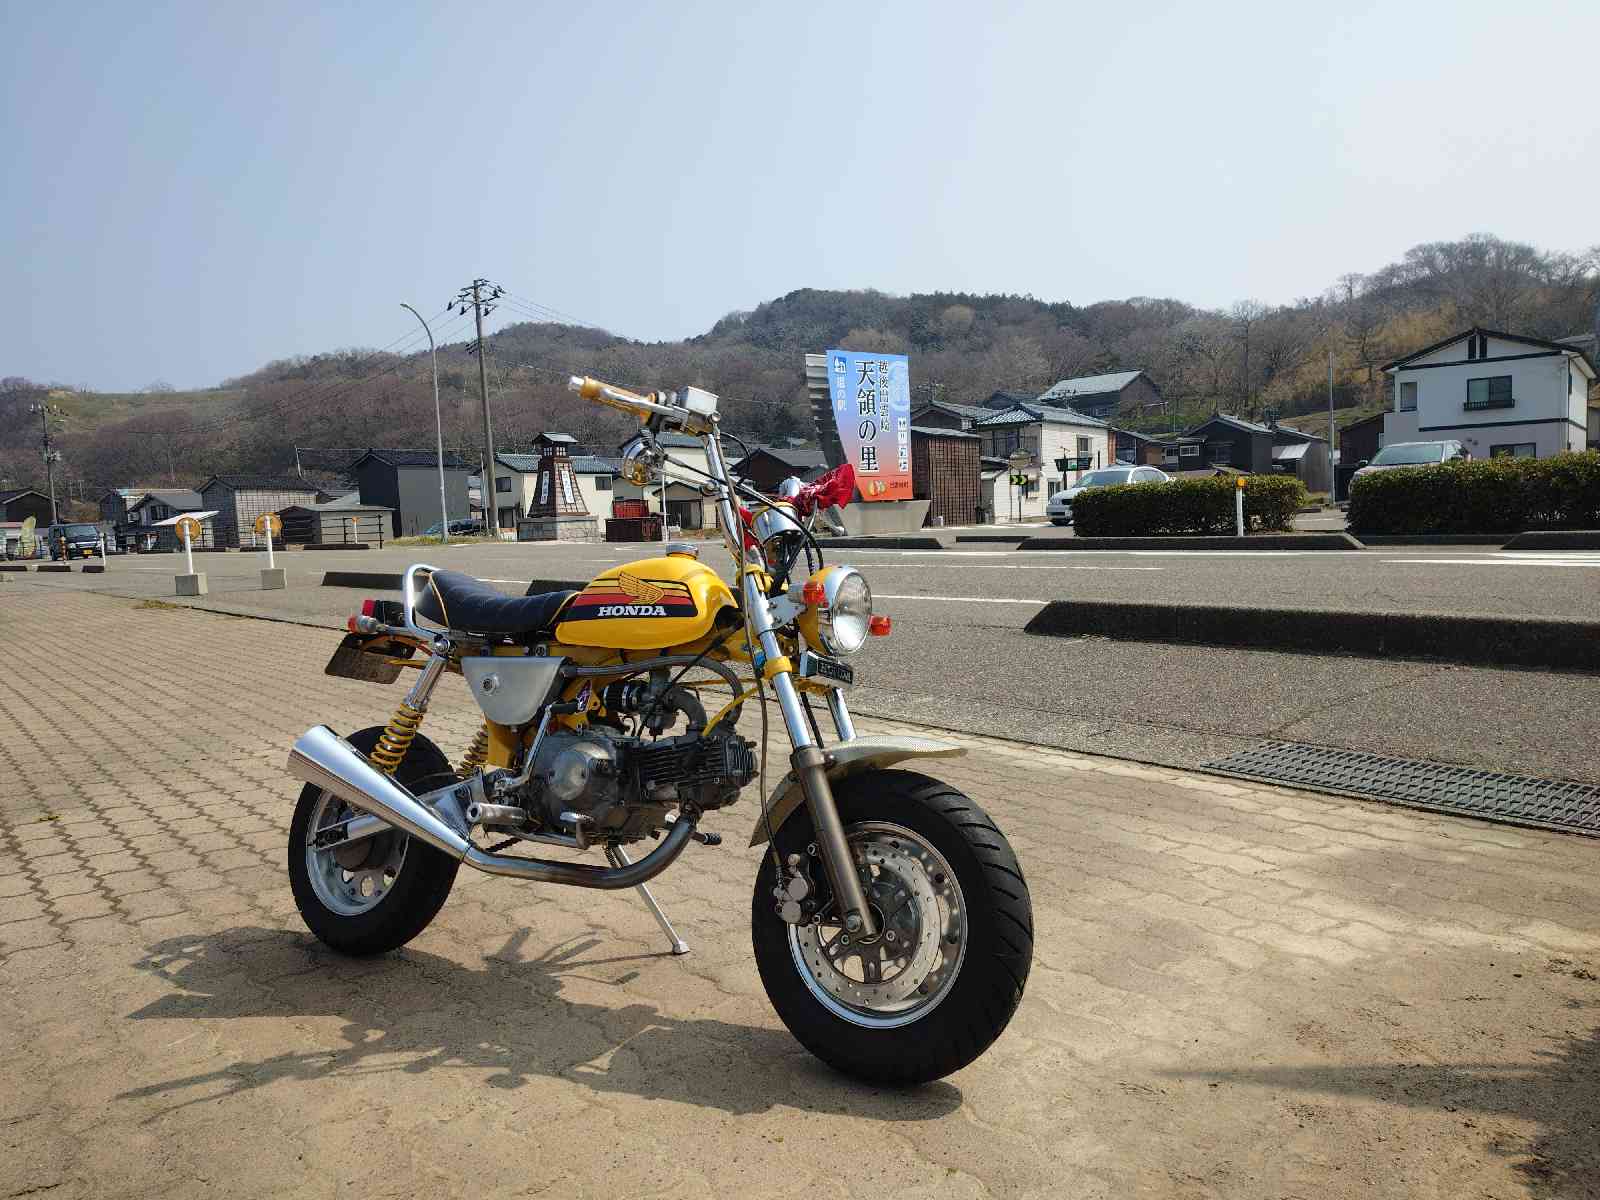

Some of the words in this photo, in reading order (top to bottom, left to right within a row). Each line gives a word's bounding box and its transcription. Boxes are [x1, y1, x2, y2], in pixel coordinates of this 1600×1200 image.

[856, 361, 879, 471] 天領の里
[598, 605, 667, 617] HONDA
